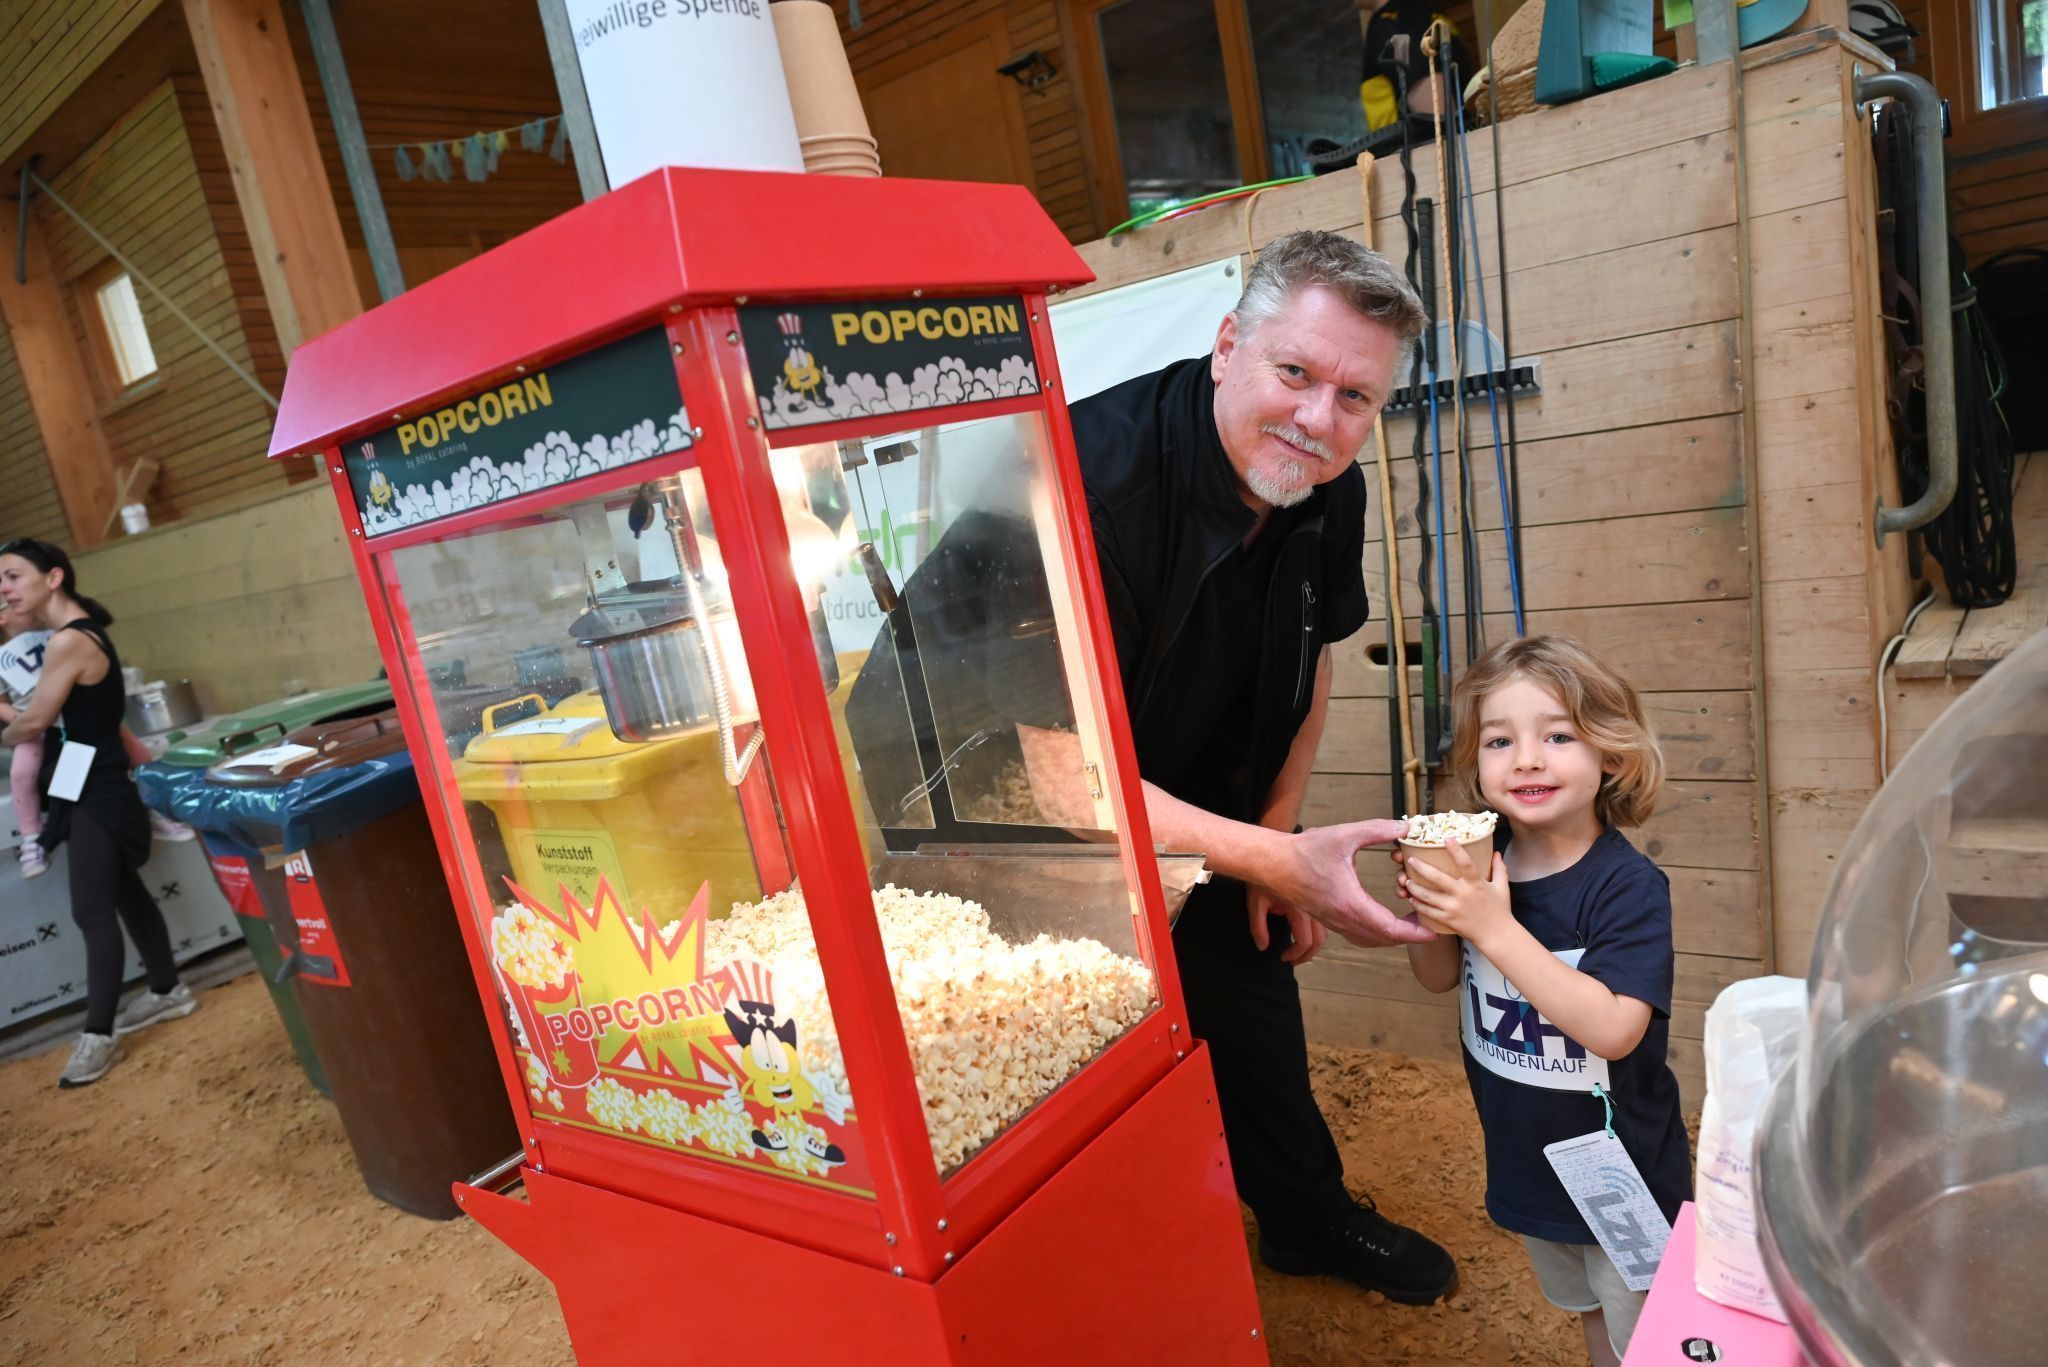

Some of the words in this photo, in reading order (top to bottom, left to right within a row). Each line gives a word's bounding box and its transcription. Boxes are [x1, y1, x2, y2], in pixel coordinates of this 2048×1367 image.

[677, 0, 761, 19] Spende
[831, 304, 1020, 347] POPCORN
[397, 372, 553, 456] POPCORN
[535, 843, 594, 860] Kunststoff
[544, 978, 726, 1046] POPCORN
[1475, 1034, 1588, 1074] STUNDENLAUF
